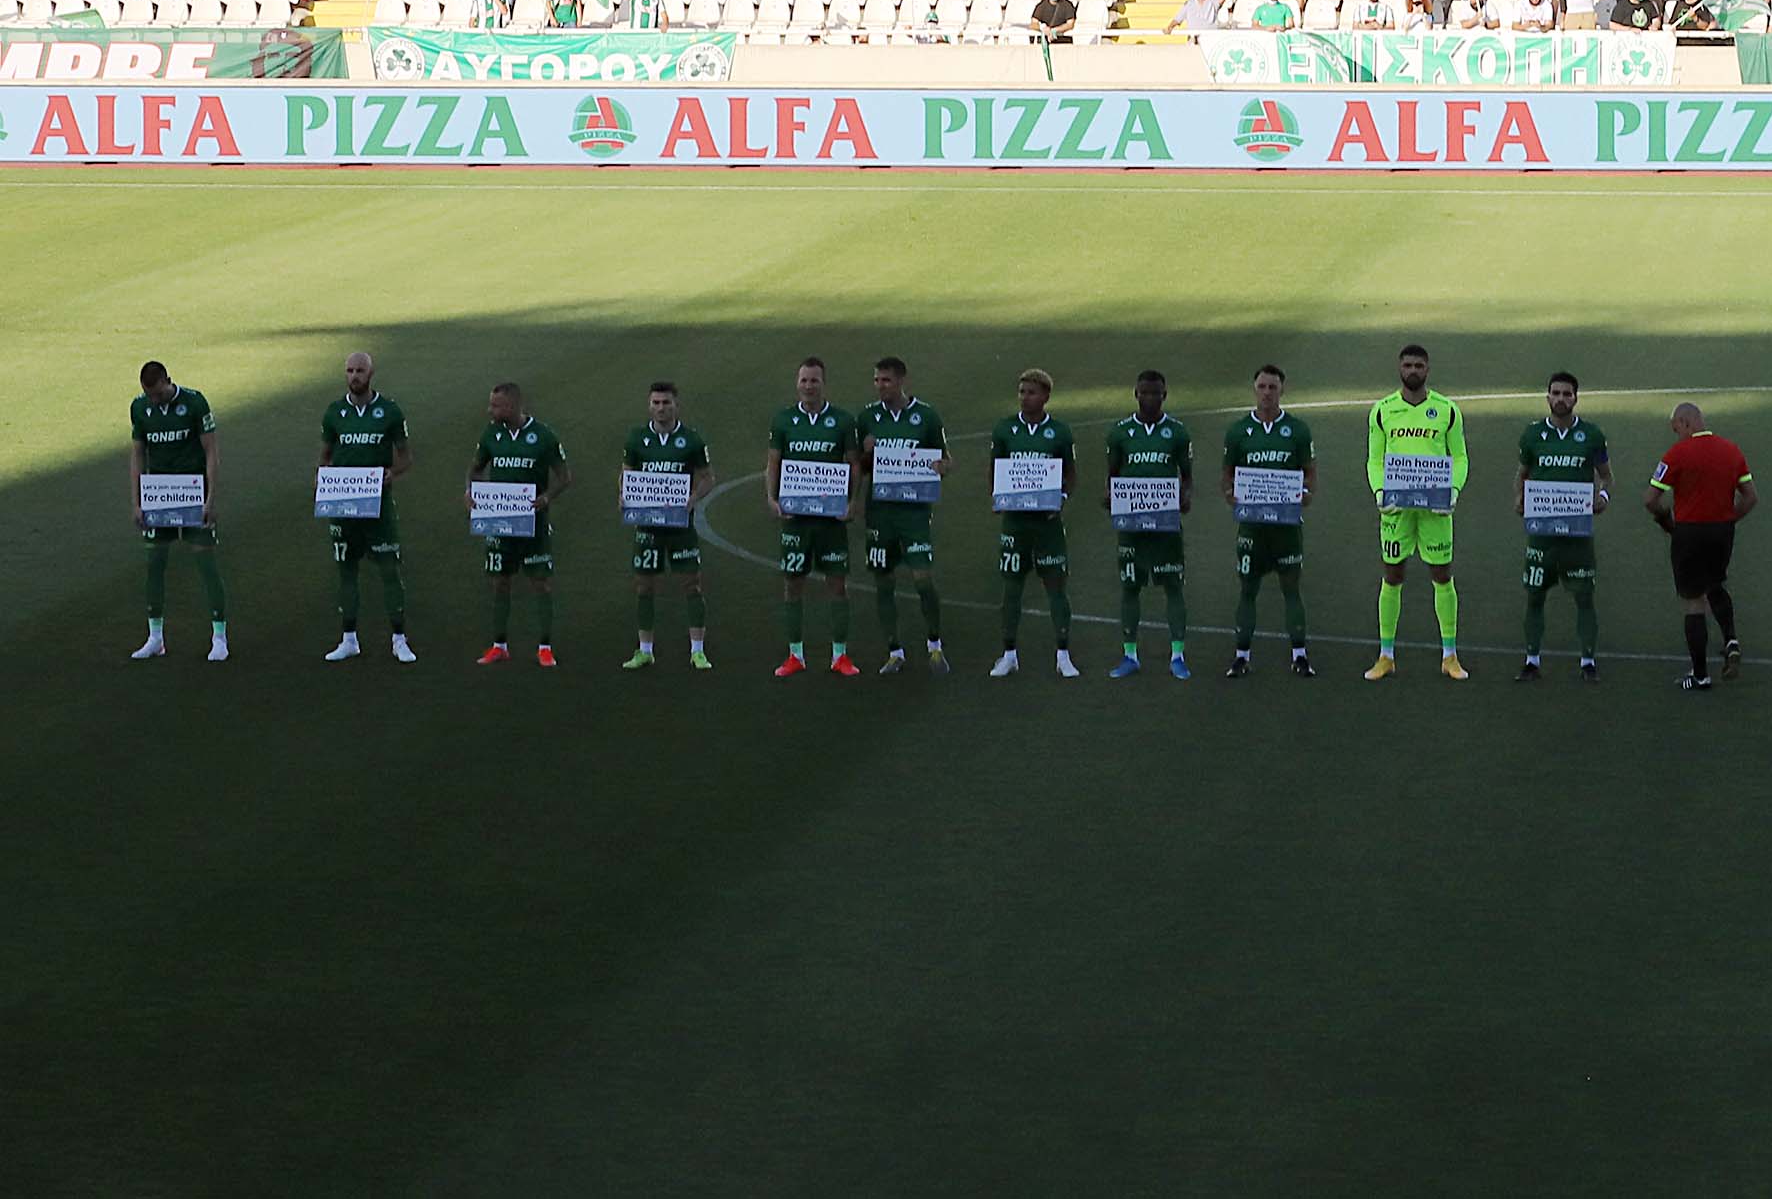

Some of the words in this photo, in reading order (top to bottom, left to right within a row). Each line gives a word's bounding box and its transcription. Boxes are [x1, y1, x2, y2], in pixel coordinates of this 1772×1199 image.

[30, 95, 243, 156] ALFA
[285, 95, 529, 157] PIZZA
[660, 97, 880, 159] ALFA
[923, 97, 1174, 161] PIZZA
[1327, 100, 1551, 163] ALFA
[147, 429, 191, 444] FONBET
[339, 434, 385, 446] FONBET
[1390, 428, 1440, 440] FONBET
[788, 441, 837, 452] FONBET
[492, 457, 537, 469] FONBET
[876, 456, 902, 467] Κάνε
[904, 456, 933, 470] πράξ
[1127, 452, 1172, 464] FONBET
[1246, 450, 1292, 464] FONBET
[1387, 457, 1412, 467] Join
[1414, 457, 1450, 469] hands
[1538, 455, 1587, 468] FONBET
[641, 461, 687, 473] FONBET
[785, 464, 812, 475] Όλοι
[813, 464, 847, 478] δίπλα
[321, 475, 341, 485] You
[342, 477, 363, 485] can
[365, 475, 380, 484] be
[626, 475, 638, 483] Το
[638, 474, 688, 487] συμφέρον
[1394, 473, 1423, 483] happy
[1424, 474, 1449, 483] place
[327, 485, 357, 493] child's
[358, 486, 379, 494] hero
[626, 486, 644, 495] του
[646, 485, 687, 495] παιδιού
[1112, 481, 1149, 490] Κανένα
[1149, 480, 1176, 490] παιδί
[143, 493, 158, 503] for
[160, 493, 203, 503] children
[1113, 491, 1127, 499] να
[1129, 491, 1149, 504] μην
[1150, 490, 1176, 499] είναι
[1533, 496, 1550, 504] στο
[1551, 496, 1585, 507] μέλλον
[1129, 499, 1160, 511] μόνο
[332, 542, 347, 562] 17
[1384, 541, 1401, 558] 40
[487, 552, 504, 572] 13
[642, 549, 659, 569] 21
[787, 552, 806, 572] 22
[1003, 552, 1021, 573] 70
[1240, 554, 1251, 575] 8
[1528, 566, 1545, 586] 16
